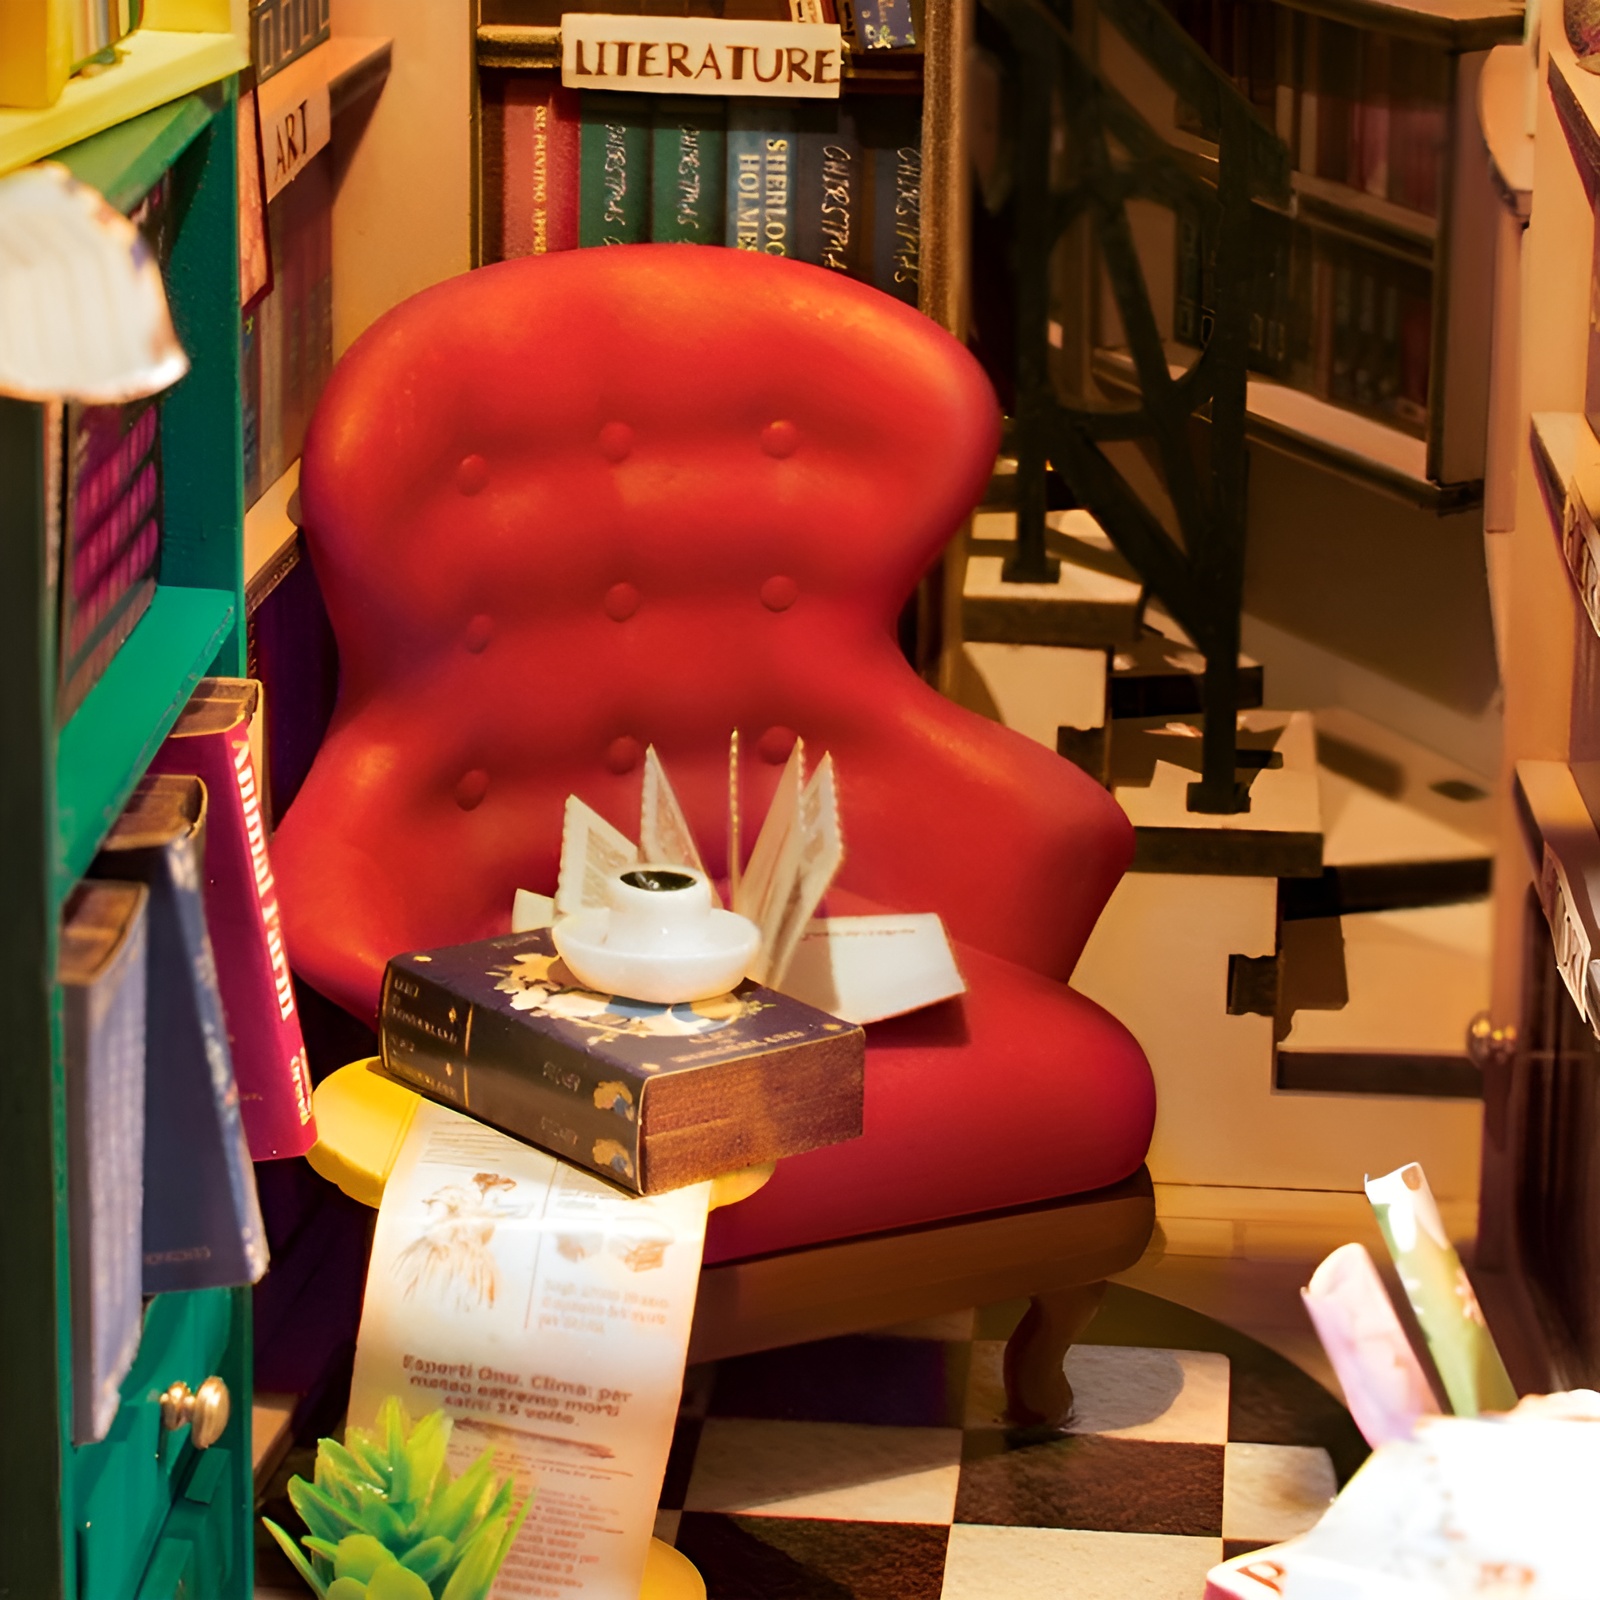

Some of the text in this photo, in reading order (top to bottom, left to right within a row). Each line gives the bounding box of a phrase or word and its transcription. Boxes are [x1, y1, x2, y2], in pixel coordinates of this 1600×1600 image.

[575, 39, 840, 84] LITERATURE
[274, 98, 308, 184] ART
[764, 138, 788, 257] SHERLOC
